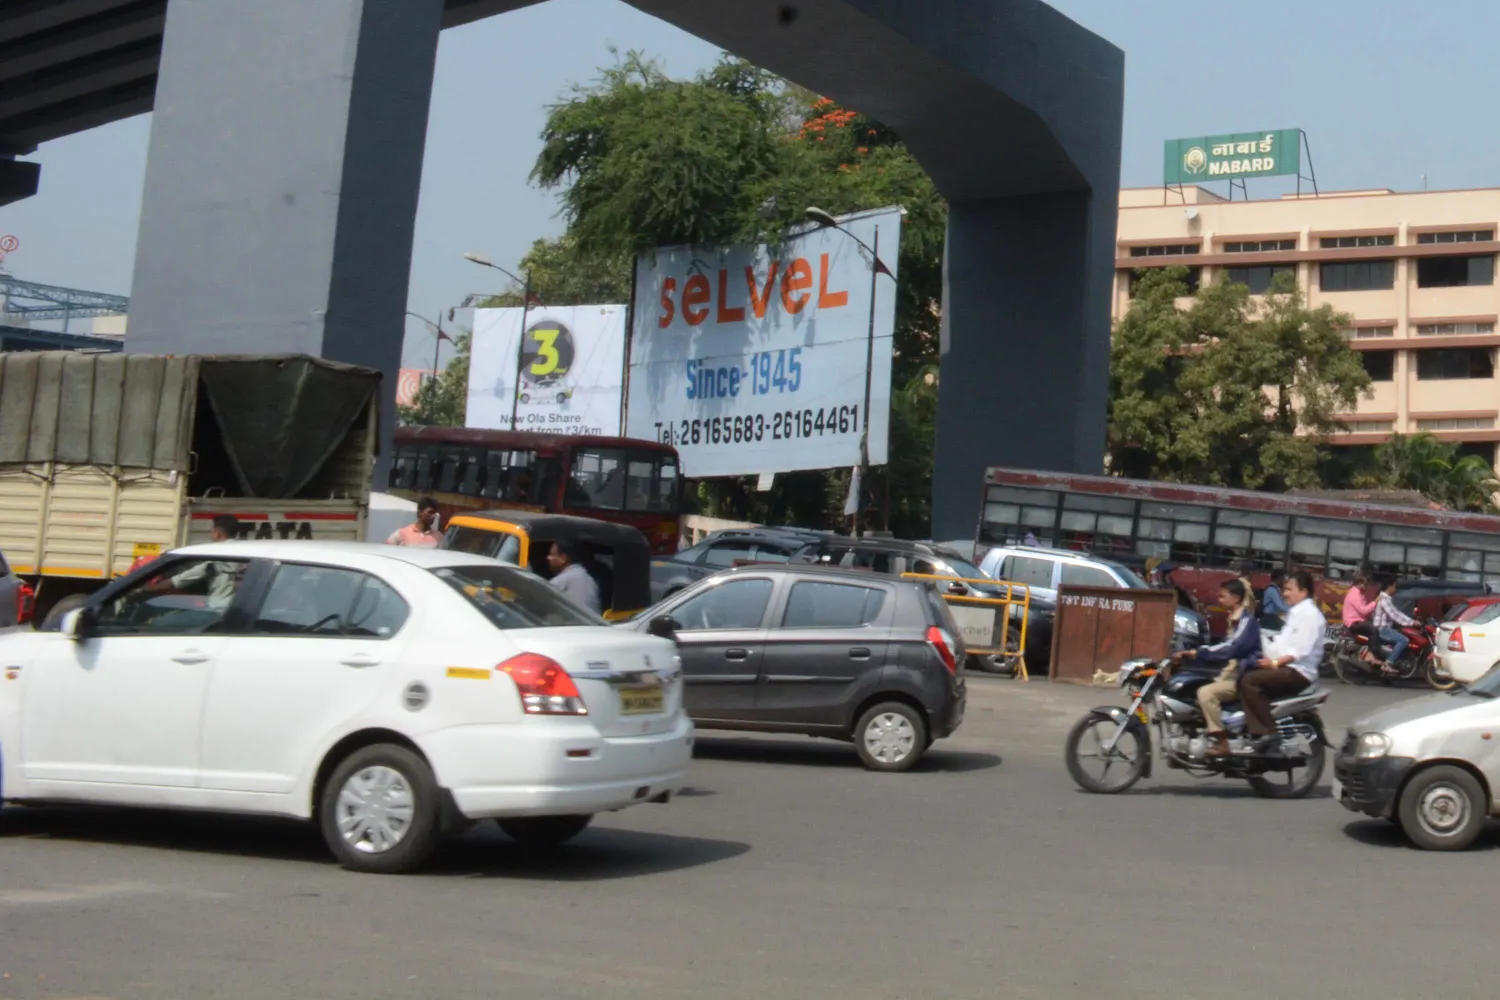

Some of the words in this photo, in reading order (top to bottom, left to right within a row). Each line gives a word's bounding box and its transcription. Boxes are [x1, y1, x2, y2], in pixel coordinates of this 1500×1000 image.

[1212, 134, 1274, 156] नाबार्ड
[1208, 157, 1275, 175] NABARD
[530, 329, 560, 376] 3
[527, 413, 546, 423] Ola
[549, 413, 581, 423] Share
[236, 522, 313, 540] TATA
